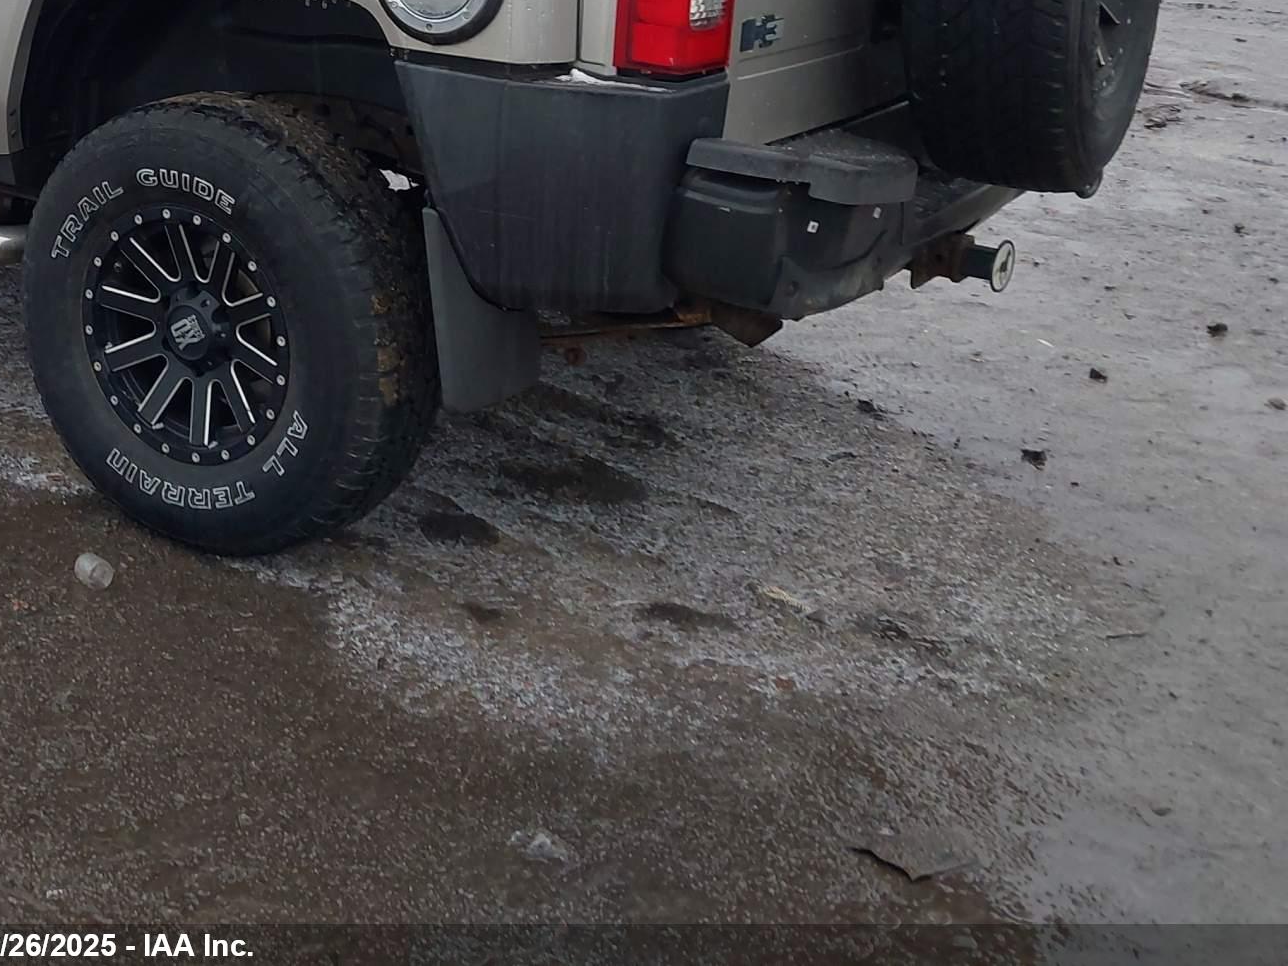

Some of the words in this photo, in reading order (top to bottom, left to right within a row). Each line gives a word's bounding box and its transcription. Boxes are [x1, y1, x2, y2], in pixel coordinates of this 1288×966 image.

[51, 180, 125, 260] TRAIL
[135, 167, 236, 215] GUIDE
[262, 410, 310, 476] ALL
[106, 447, 257, 510] TERRAIN
